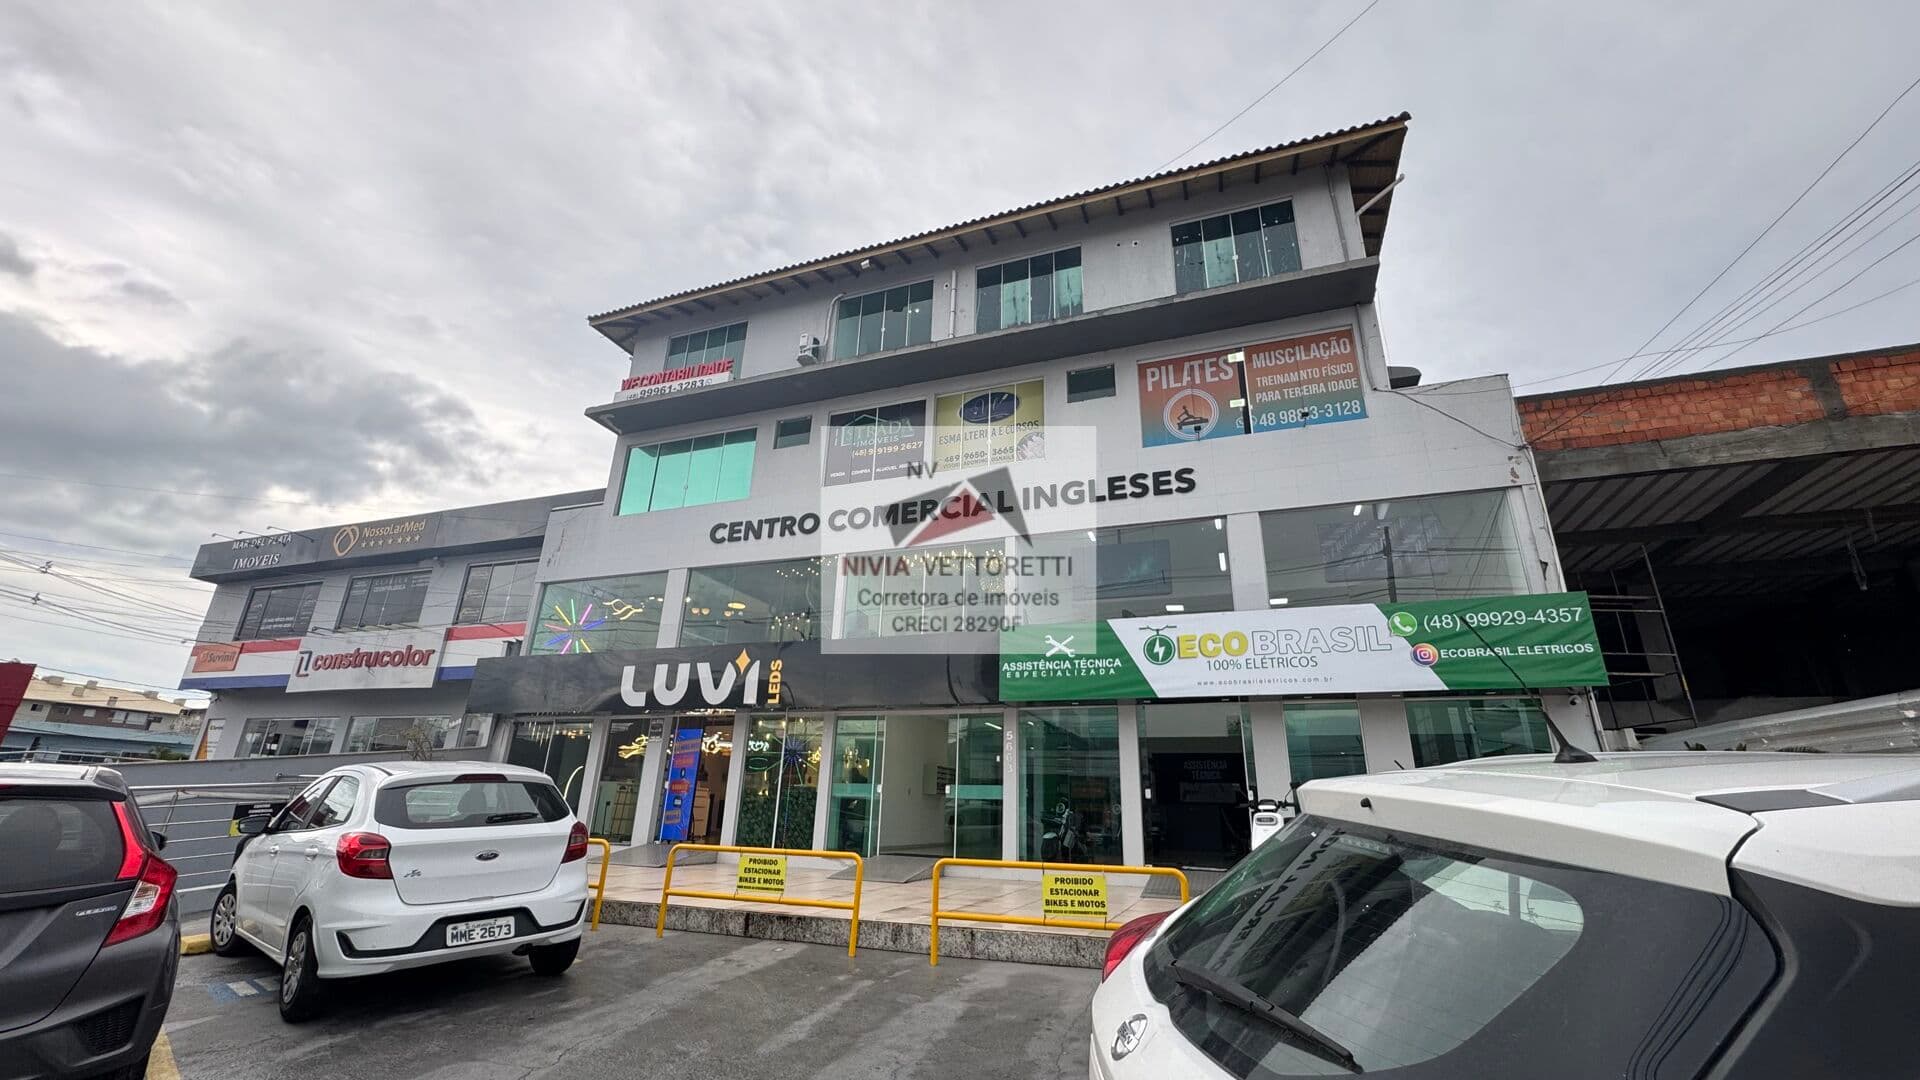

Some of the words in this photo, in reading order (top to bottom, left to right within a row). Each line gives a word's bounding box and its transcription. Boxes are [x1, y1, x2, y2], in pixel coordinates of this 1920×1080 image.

[1146, 356, 1234, 392] PILATES
[1322, 362, 1354, 378] FÍSICO
[640, 379, 705, 399] 99961-3283
[1255, 389, 1281, 404] PARA
[1283, 381, 1326, 399] TEREIRA
[1328, 377, 1360, 393] IDADE
[1005, 419, 1040, 435] CURSOS
[1259, 412, 1277, 428] 48
[900, 440, 923, 452] 2627
[709, 512, 820, 545] CENTRO
[828, 490, 1014, 532] COMERCIAL
[1022, 467, 1197, 510] INGLESES
[362, 519, 426, 538] NossoLarMed
[1423, 614, 1461, 632] (48)
[1465, 607, 1582, 628] 99929-4357
[312, 645, 435, 671] construcolor
[1440, 643, 1594, 659] ECOBRASIL.ELETRICOS
[1003, 659, 1072, 673] ASSISTÊNCIA
[1074, 657, 1122, 669] TÉCNICA
[1207, 659, 1242, 671] 100%
[1245, 656, 1318, 671] ELÉTRICOS
[1006, 668, 1115, 679] ESPECIALIZADA
[621, 658, 760, 707] LUVI
[767, 659, 783, 705] LEDS
[748, 857, 778, 866] PROIBIDO
[744, 866, 781, 876] ESTACIONAR
[738, 875, 756, 884] BIKES
[763, 877, 784, 886] MOTOS
[1054, 877, 1094, 886] PROIBIDO
[1049, 887, 1099, 897] ESTACIONAR
[1045, 898, 1069, 907] BIKES
[1070, 899, 1075, 907] E
[1077, 900, 1106, 908] MOTOS
